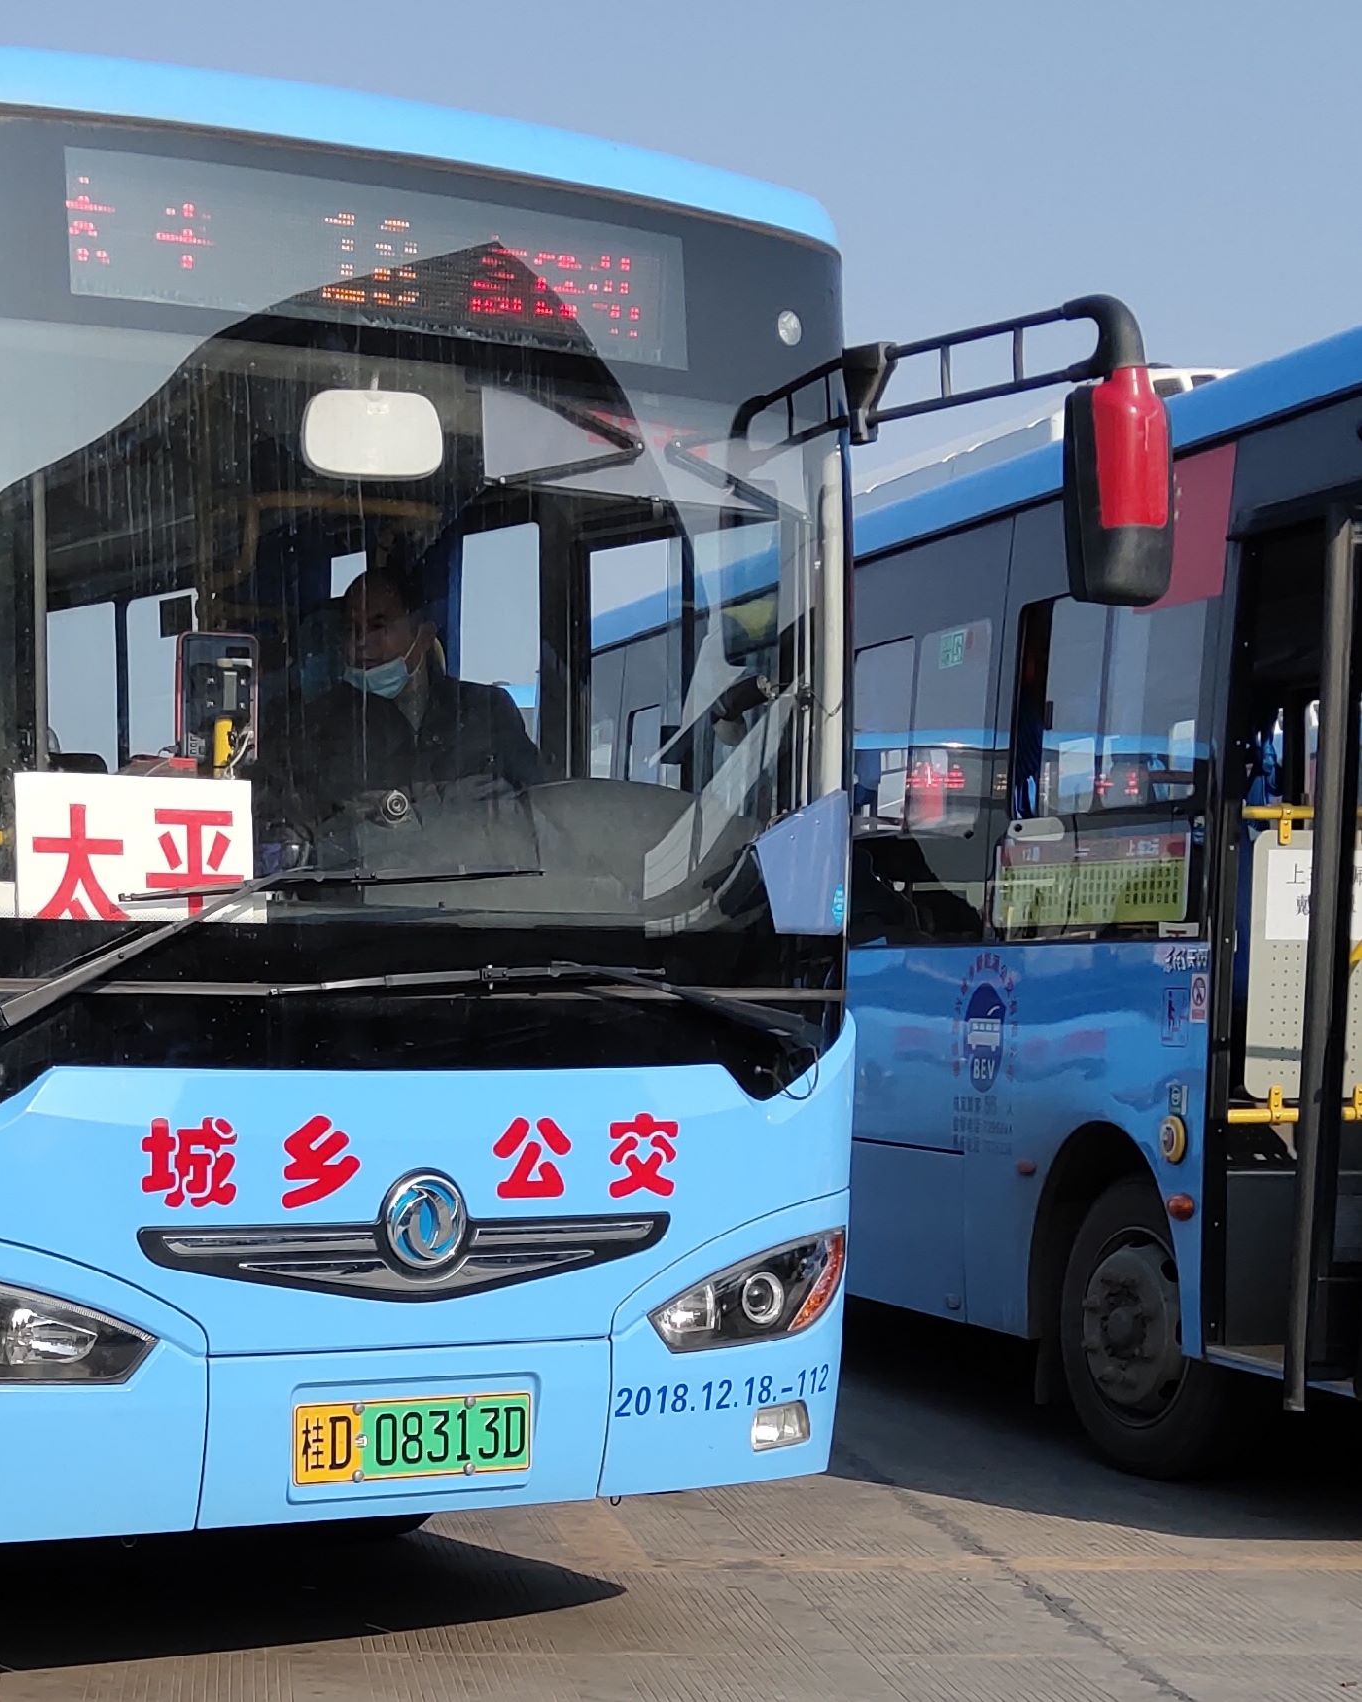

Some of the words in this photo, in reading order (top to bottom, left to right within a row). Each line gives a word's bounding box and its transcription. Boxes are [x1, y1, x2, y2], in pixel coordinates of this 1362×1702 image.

[32, 803, 244, 920] 太平
[973, 1057, 996, 1081] BEV
[375, 1406, 526, 1467] 08313D
